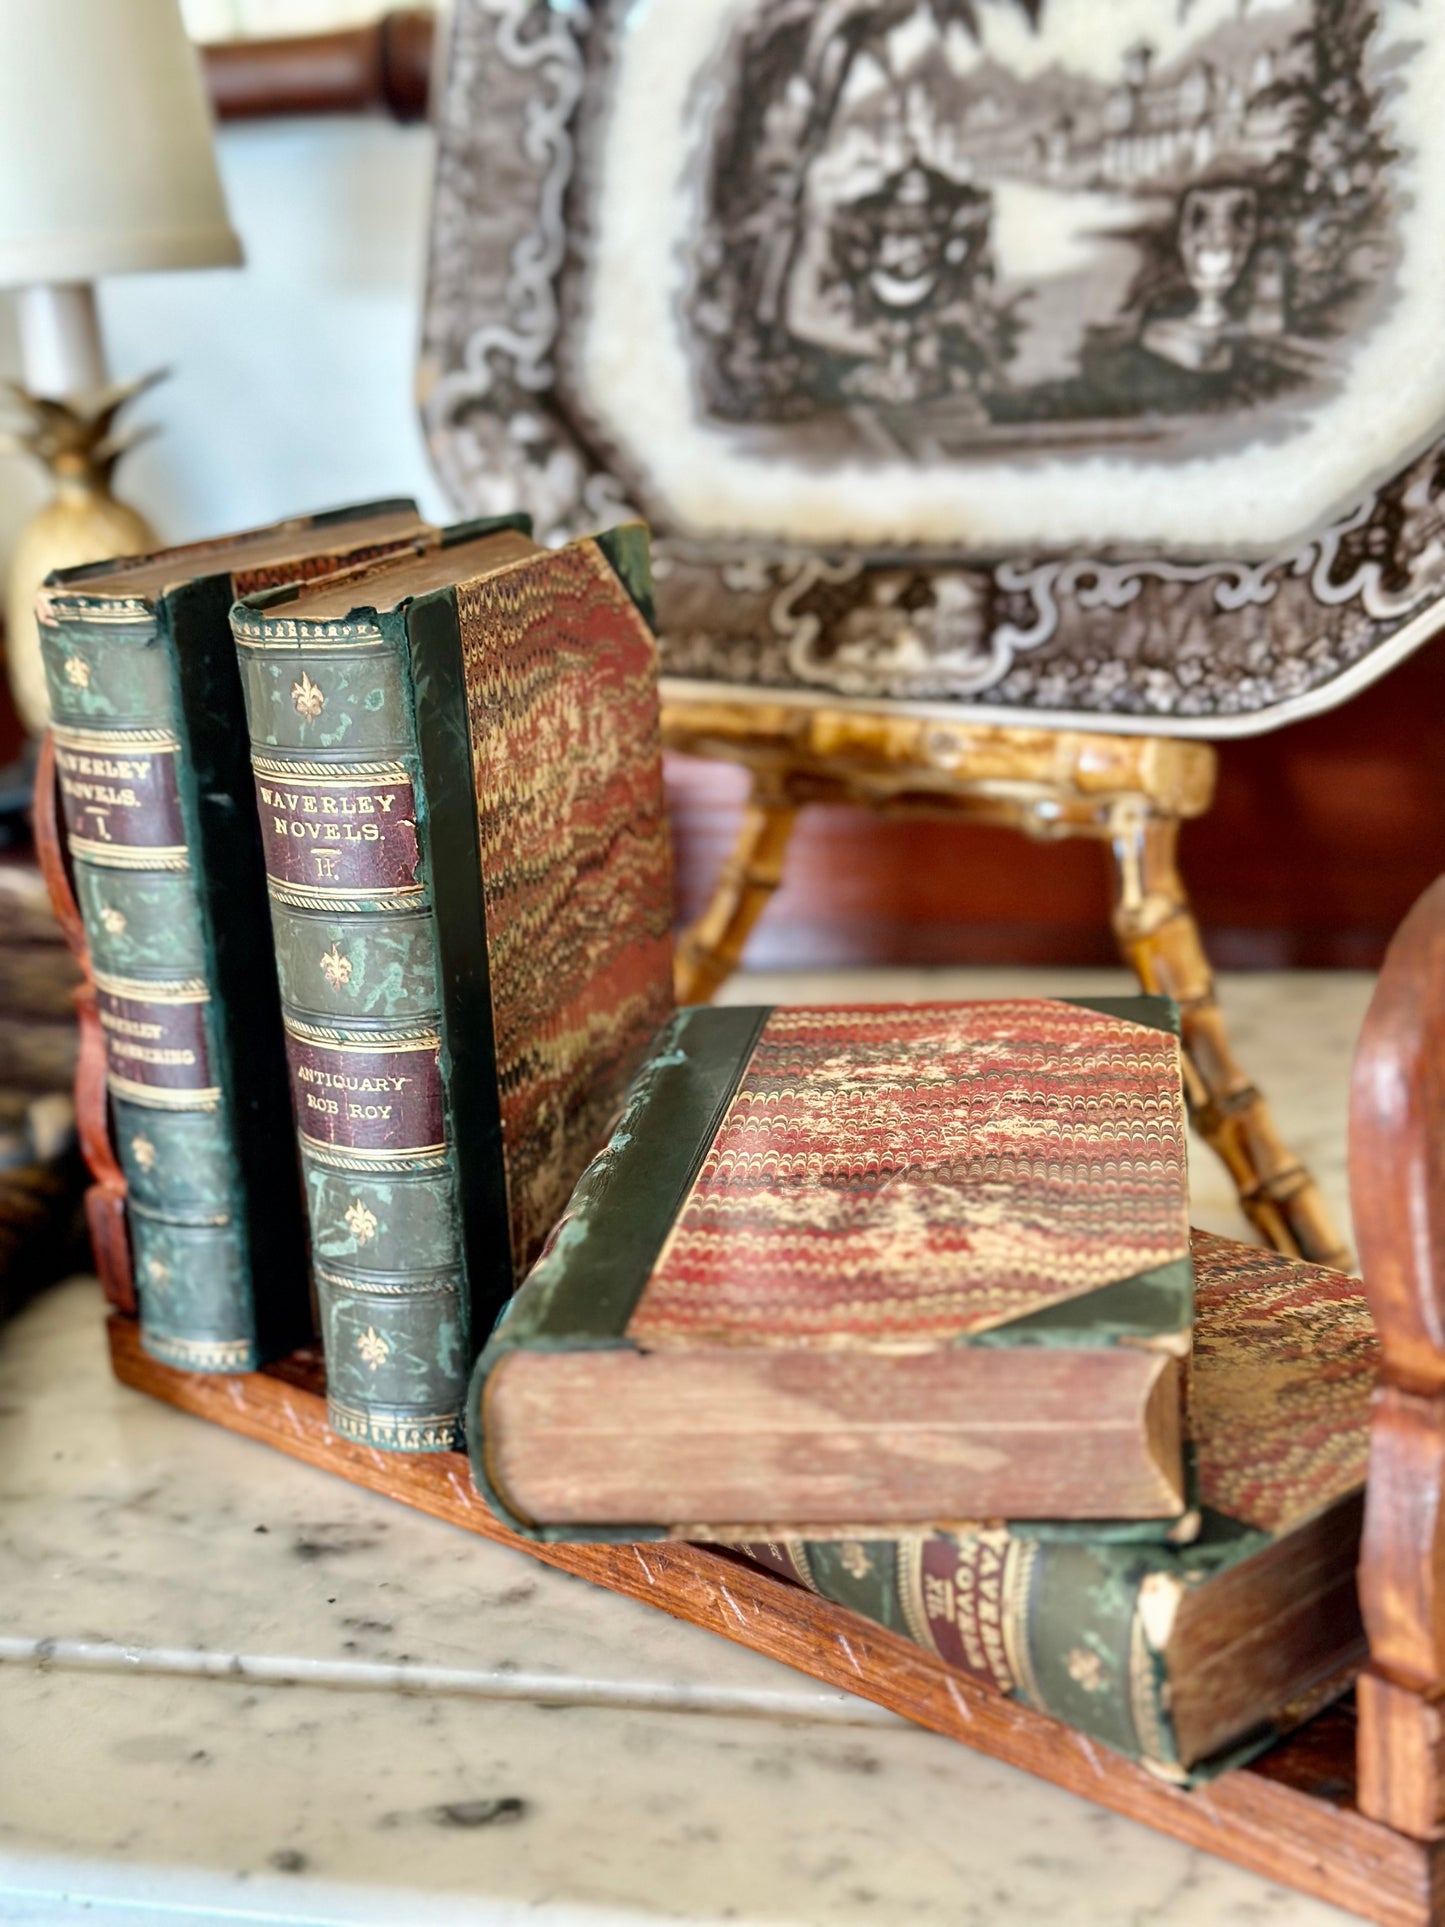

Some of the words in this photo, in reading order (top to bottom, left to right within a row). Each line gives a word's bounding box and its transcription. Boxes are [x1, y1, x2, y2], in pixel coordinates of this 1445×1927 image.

[55, 749, 152, 780] VERLEY
[260, 786, 396, 814] WAVERLEY
[273, 816, 386, 841] NOVELS.
[315, 857, 340, 881] II.
[298, 1065, 405, 1092] ANTIQUARY
[306, 1093, 340, 1115] ROB
[349, 1103, 392, 1120] ROY
